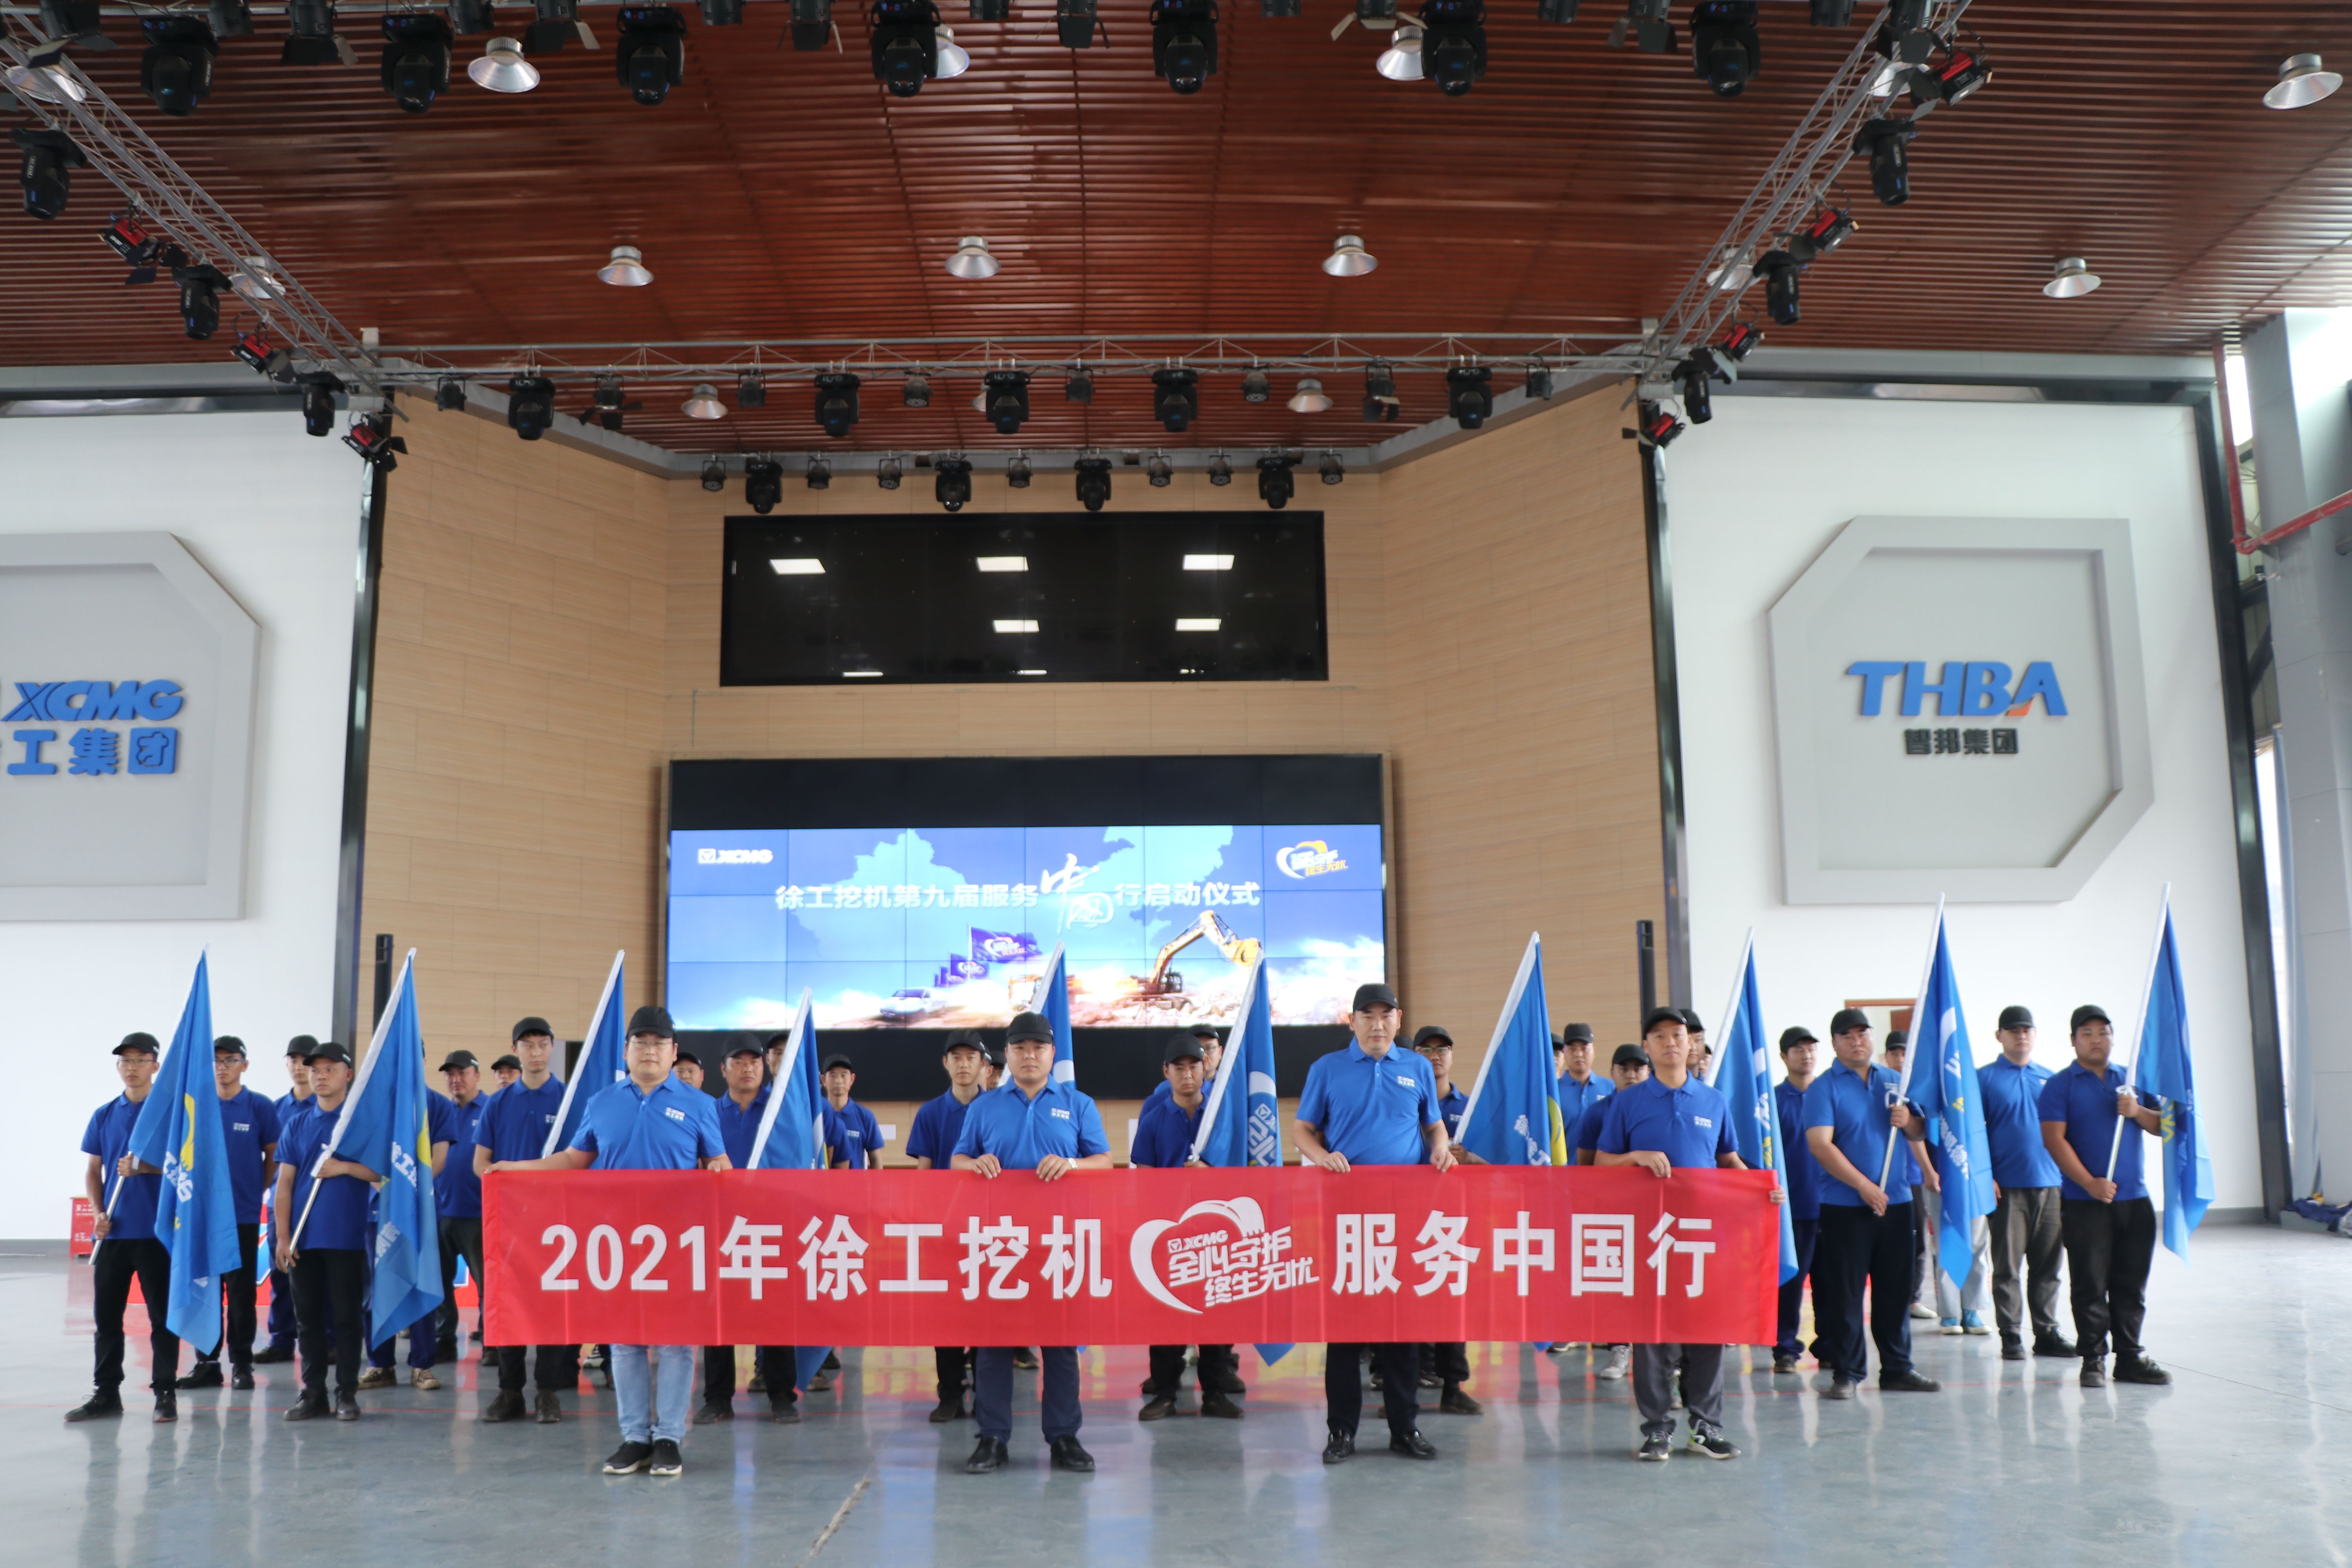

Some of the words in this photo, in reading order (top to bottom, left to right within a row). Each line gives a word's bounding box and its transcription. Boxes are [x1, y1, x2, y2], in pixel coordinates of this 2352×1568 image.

[1, 679, 183, 722] XCMG
[1846, 661, 2068, 716] THBA
[1904, 728, 2019, 754] 智邦集团
[541, 1214, 1113, 1301] 2021年徐工挖机
[1169, 1225, 1292, 1287] 全心守护
[1183, 1229, 1229, 1250] XCMG
[1332, 1210, 1716, 1298] 服务中国行
[1204, 1256, 1320, 1307] 终生无忧
